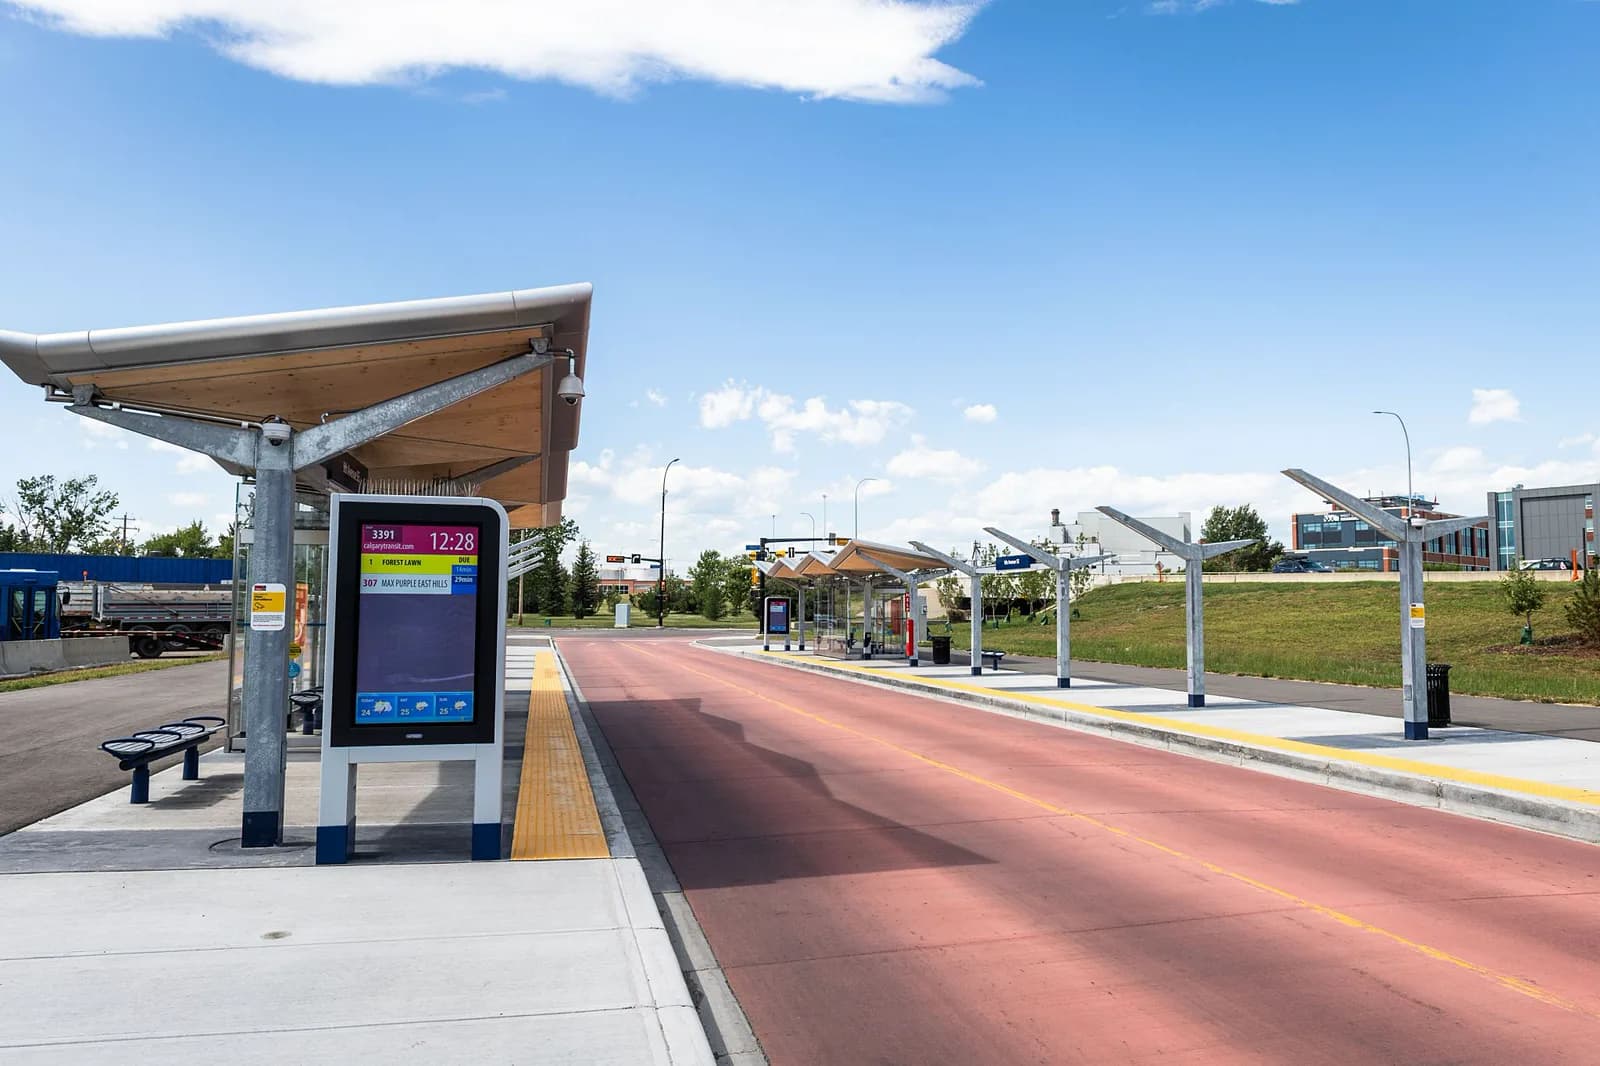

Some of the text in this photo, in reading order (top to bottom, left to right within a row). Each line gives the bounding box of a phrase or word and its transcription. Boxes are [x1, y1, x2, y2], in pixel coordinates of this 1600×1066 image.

[372, 530, 394, 540] 3391
[430, 532, 474, 551] 12:28
[363, 542, 414, 551] calgarytransit.com
[362, 579, 448, 588] 307 MAX PURPLE EAST HILLS
